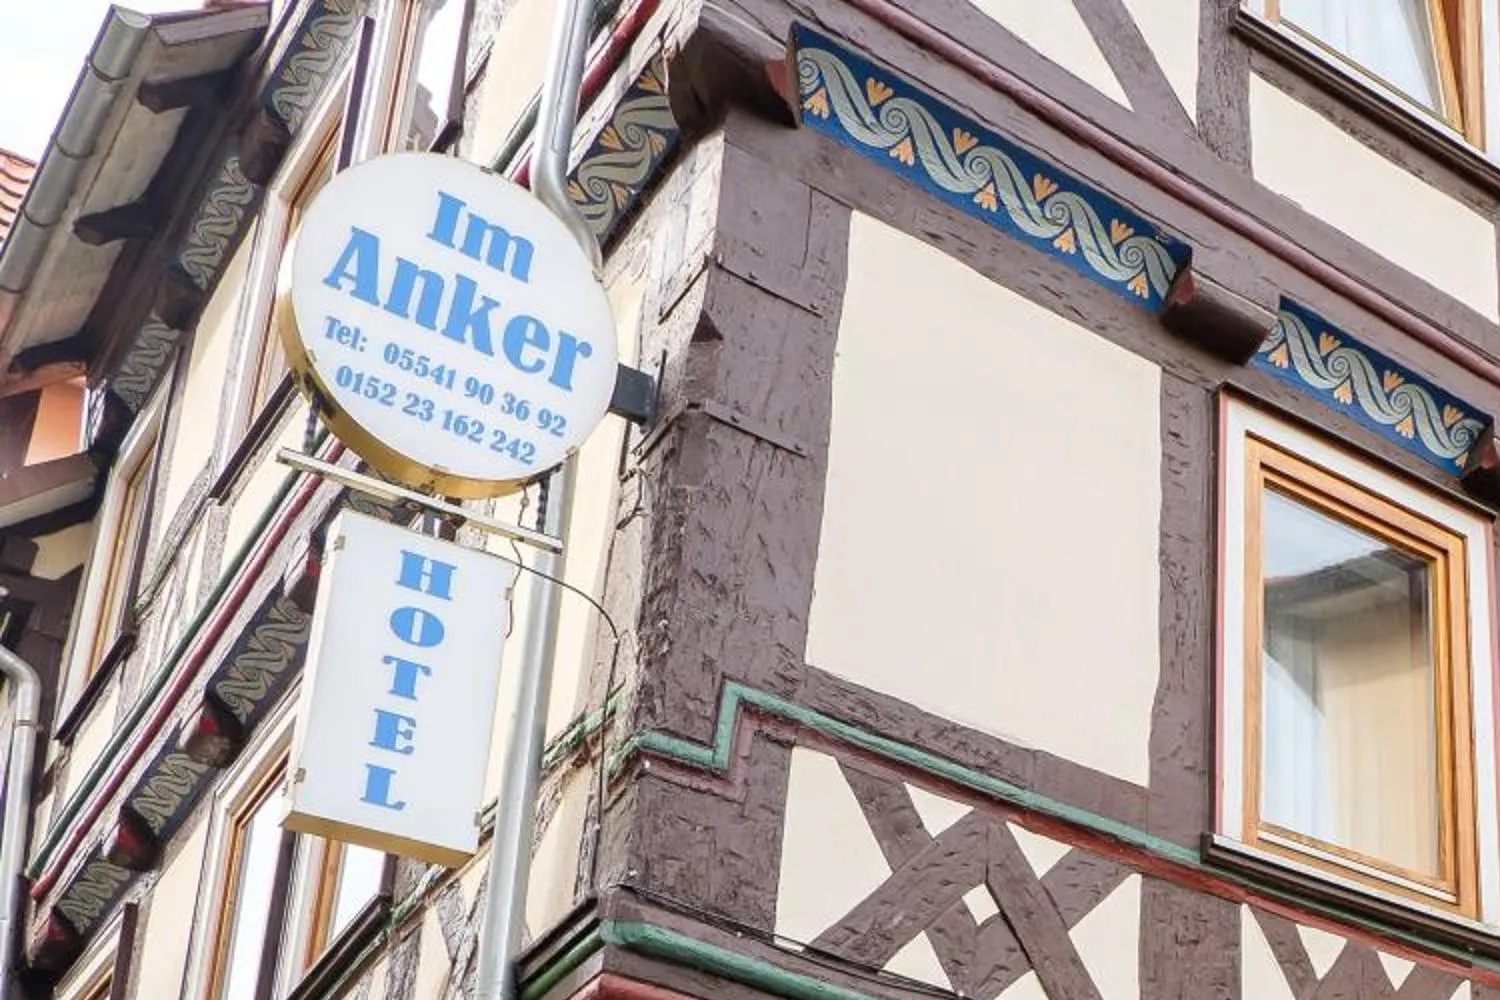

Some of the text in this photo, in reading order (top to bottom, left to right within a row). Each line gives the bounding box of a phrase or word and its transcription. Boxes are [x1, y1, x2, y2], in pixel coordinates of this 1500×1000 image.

[426, 190, 535, 283] Im
[322, 226, 592, 392] Anker
[324, 316, 567, 437] Tel: 05541 90 36 92
[335, 365, 536, 465] 0152 23 162 242
[360, 550, 457, 811] HOTEL
